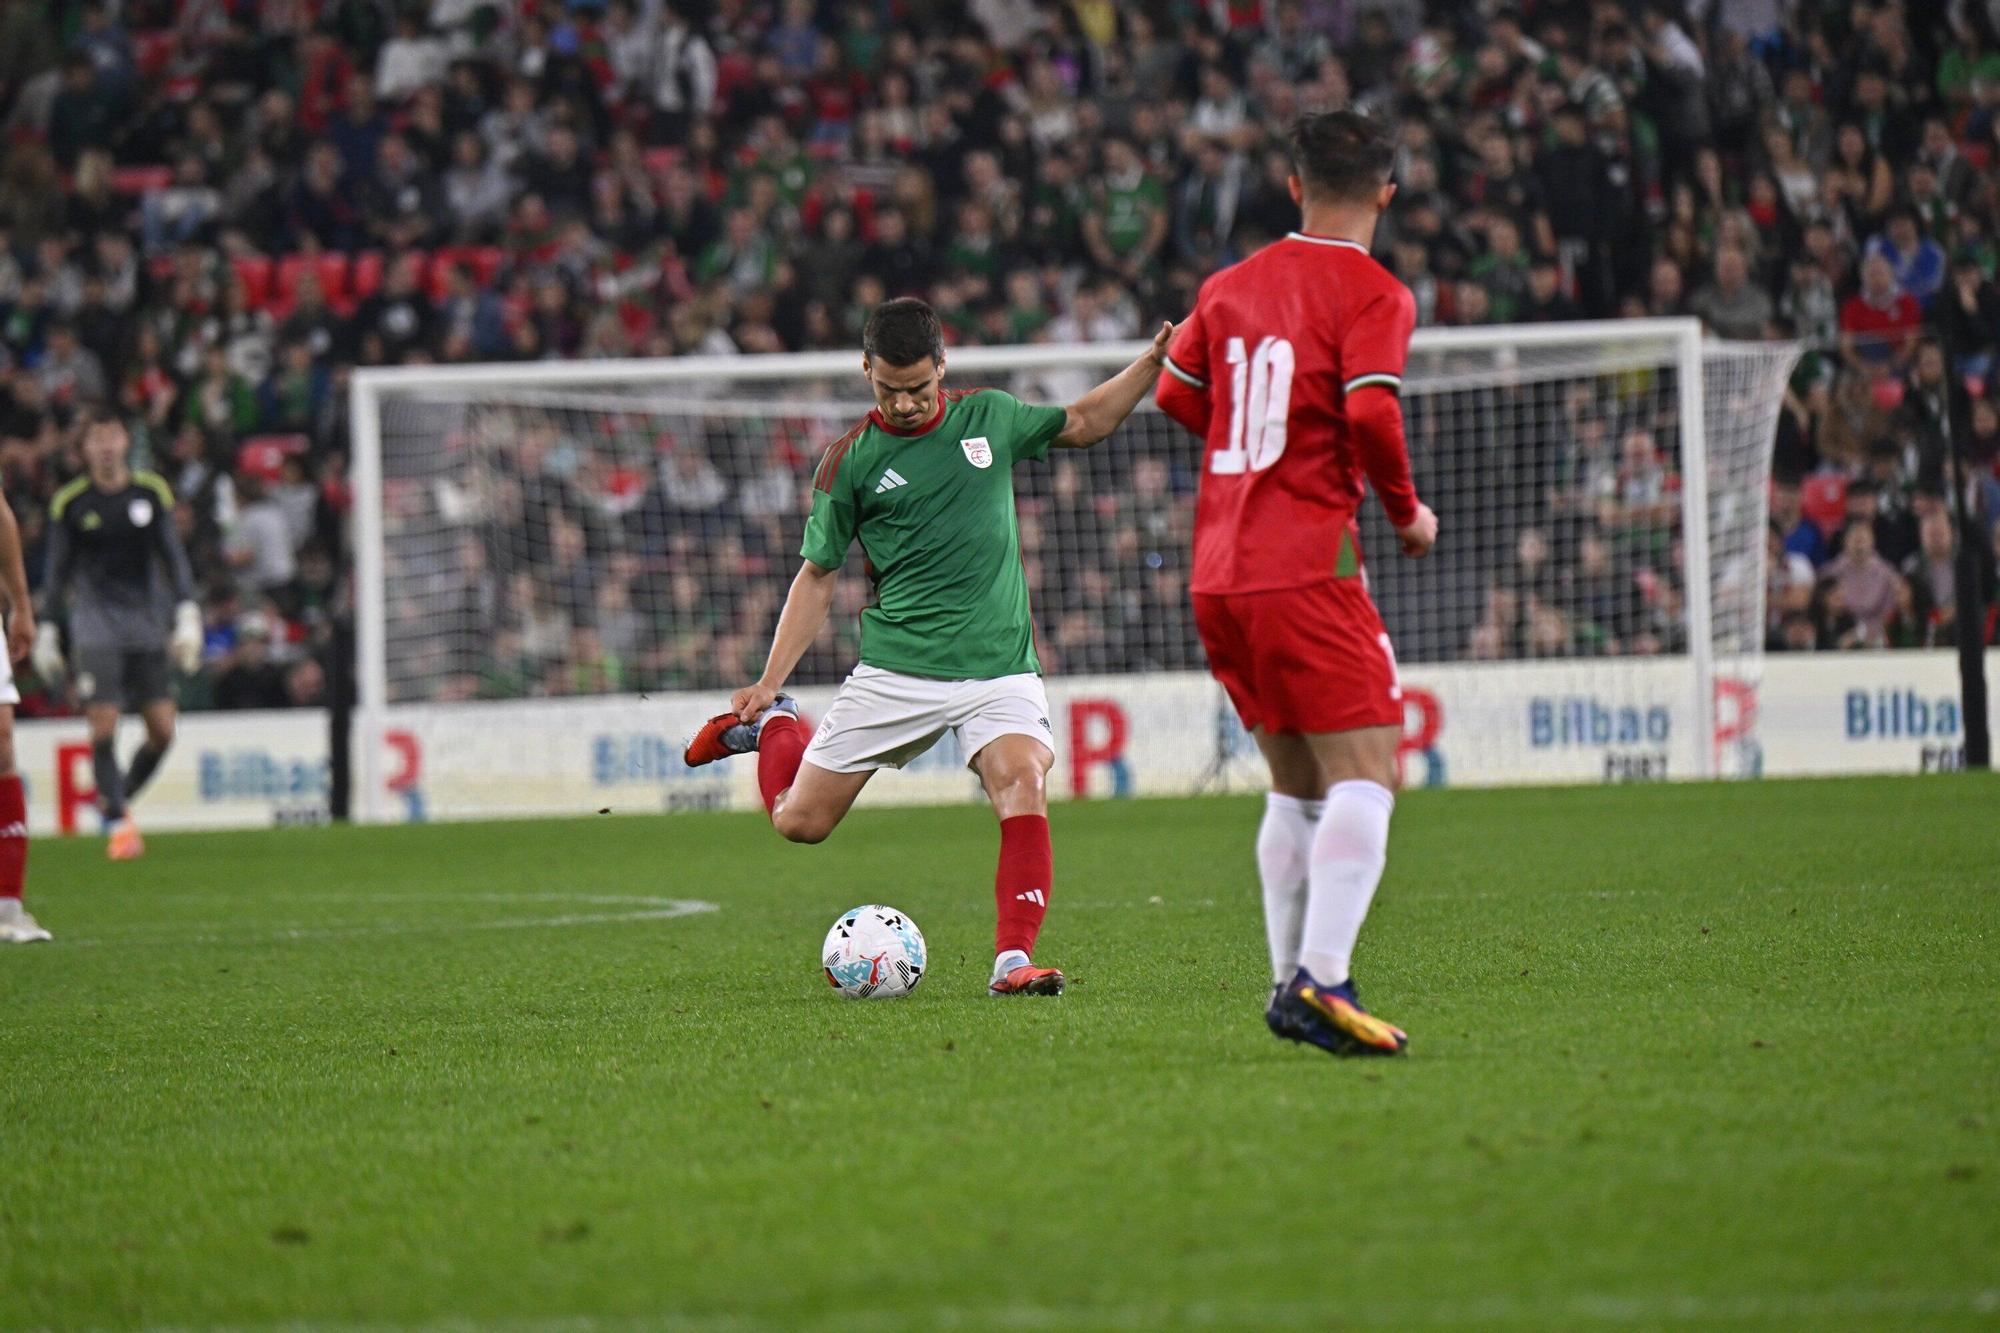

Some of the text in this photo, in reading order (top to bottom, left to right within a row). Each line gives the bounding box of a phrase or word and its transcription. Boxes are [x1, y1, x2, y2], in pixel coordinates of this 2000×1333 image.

[1210, 336, 1295, 475] 10
[1529, 698, 1671, 748] Bilbao
[1845, 688, 1957, 737] Bilba
